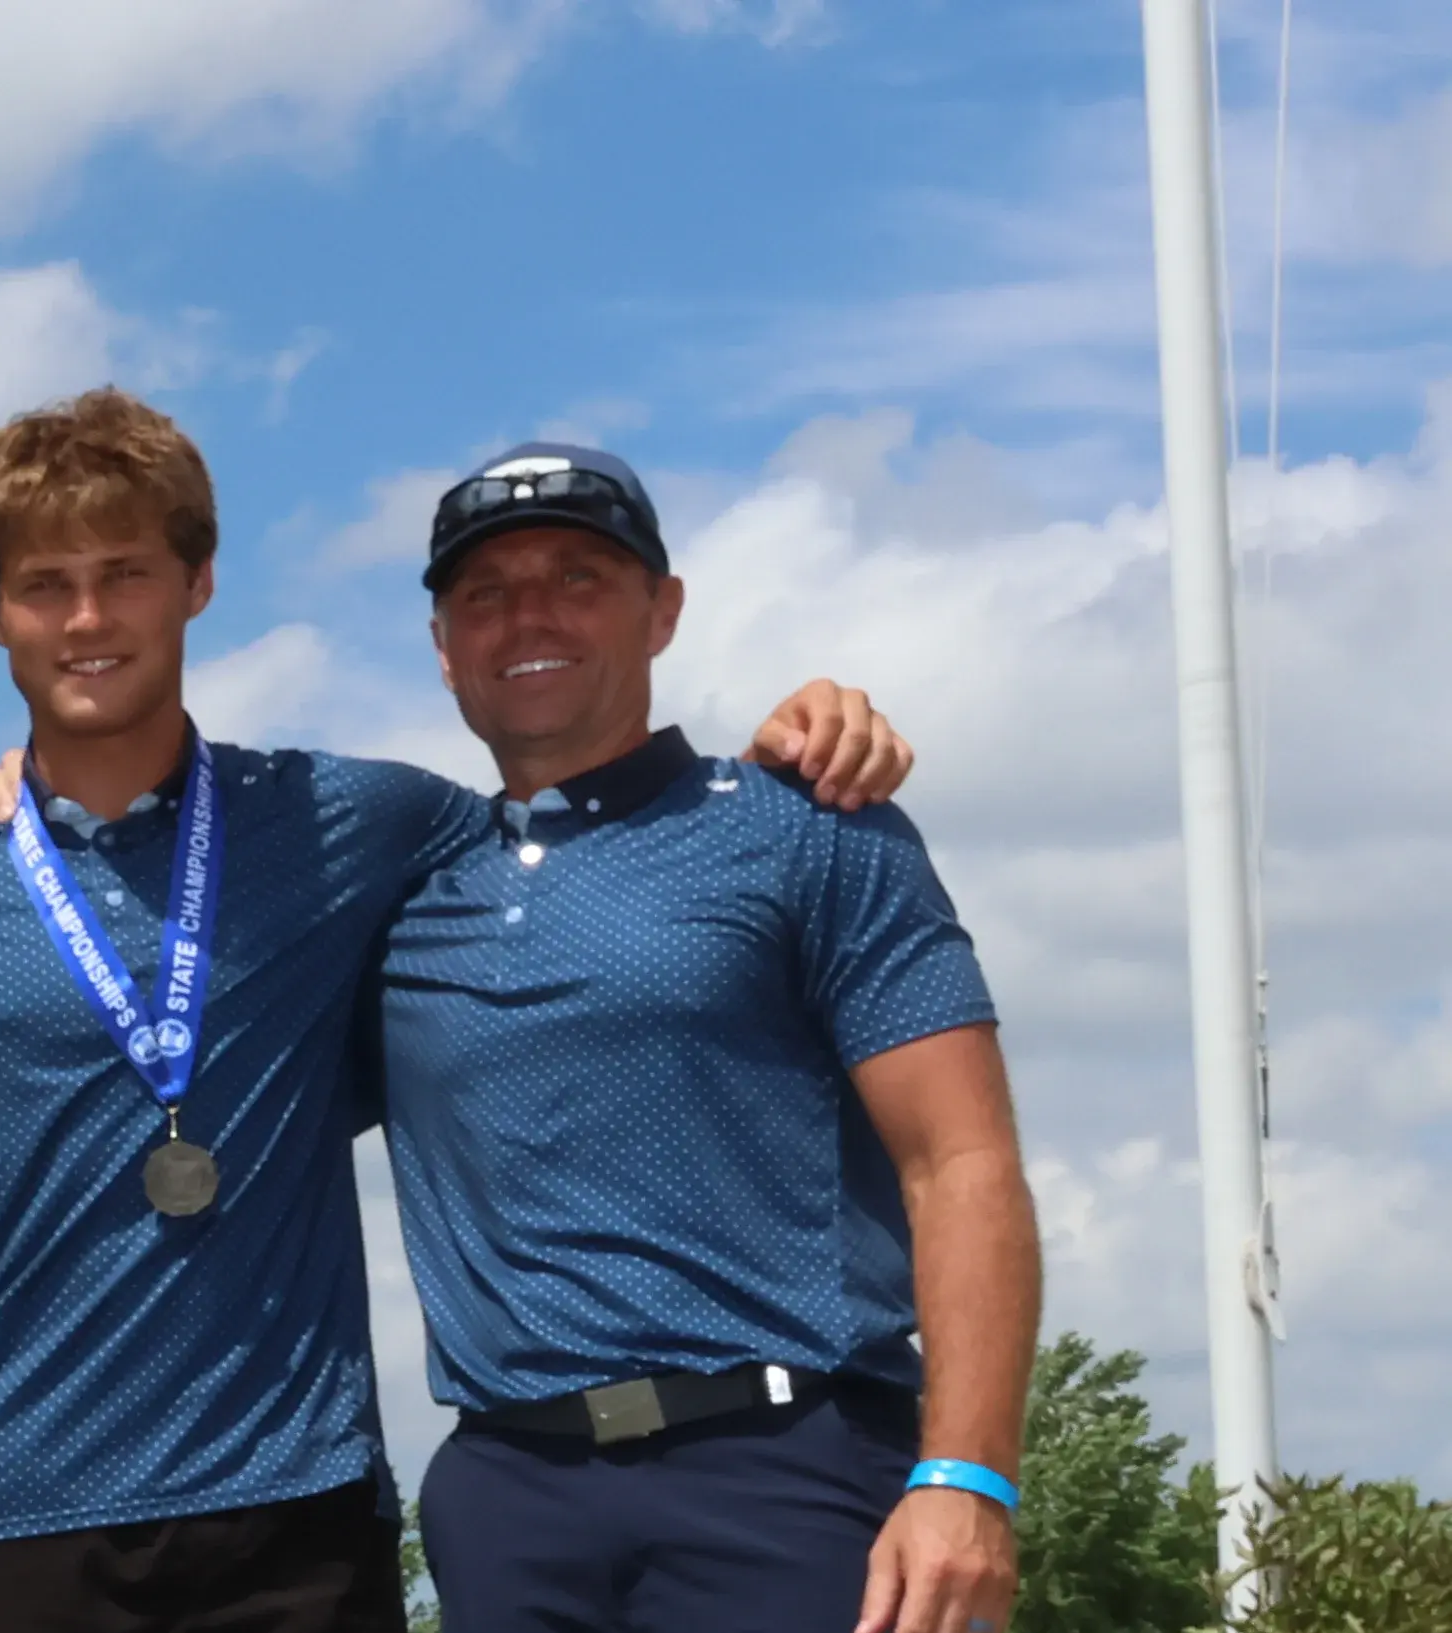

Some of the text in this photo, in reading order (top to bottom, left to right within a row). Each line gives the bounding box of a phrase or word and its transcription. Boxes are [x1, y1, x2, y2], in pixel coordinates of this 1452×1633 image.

[34, 866, 137, 1029] CHAMPIONSHIPS
[166, 763, 214, 1013] STATE CHAMPIONSHIPS
